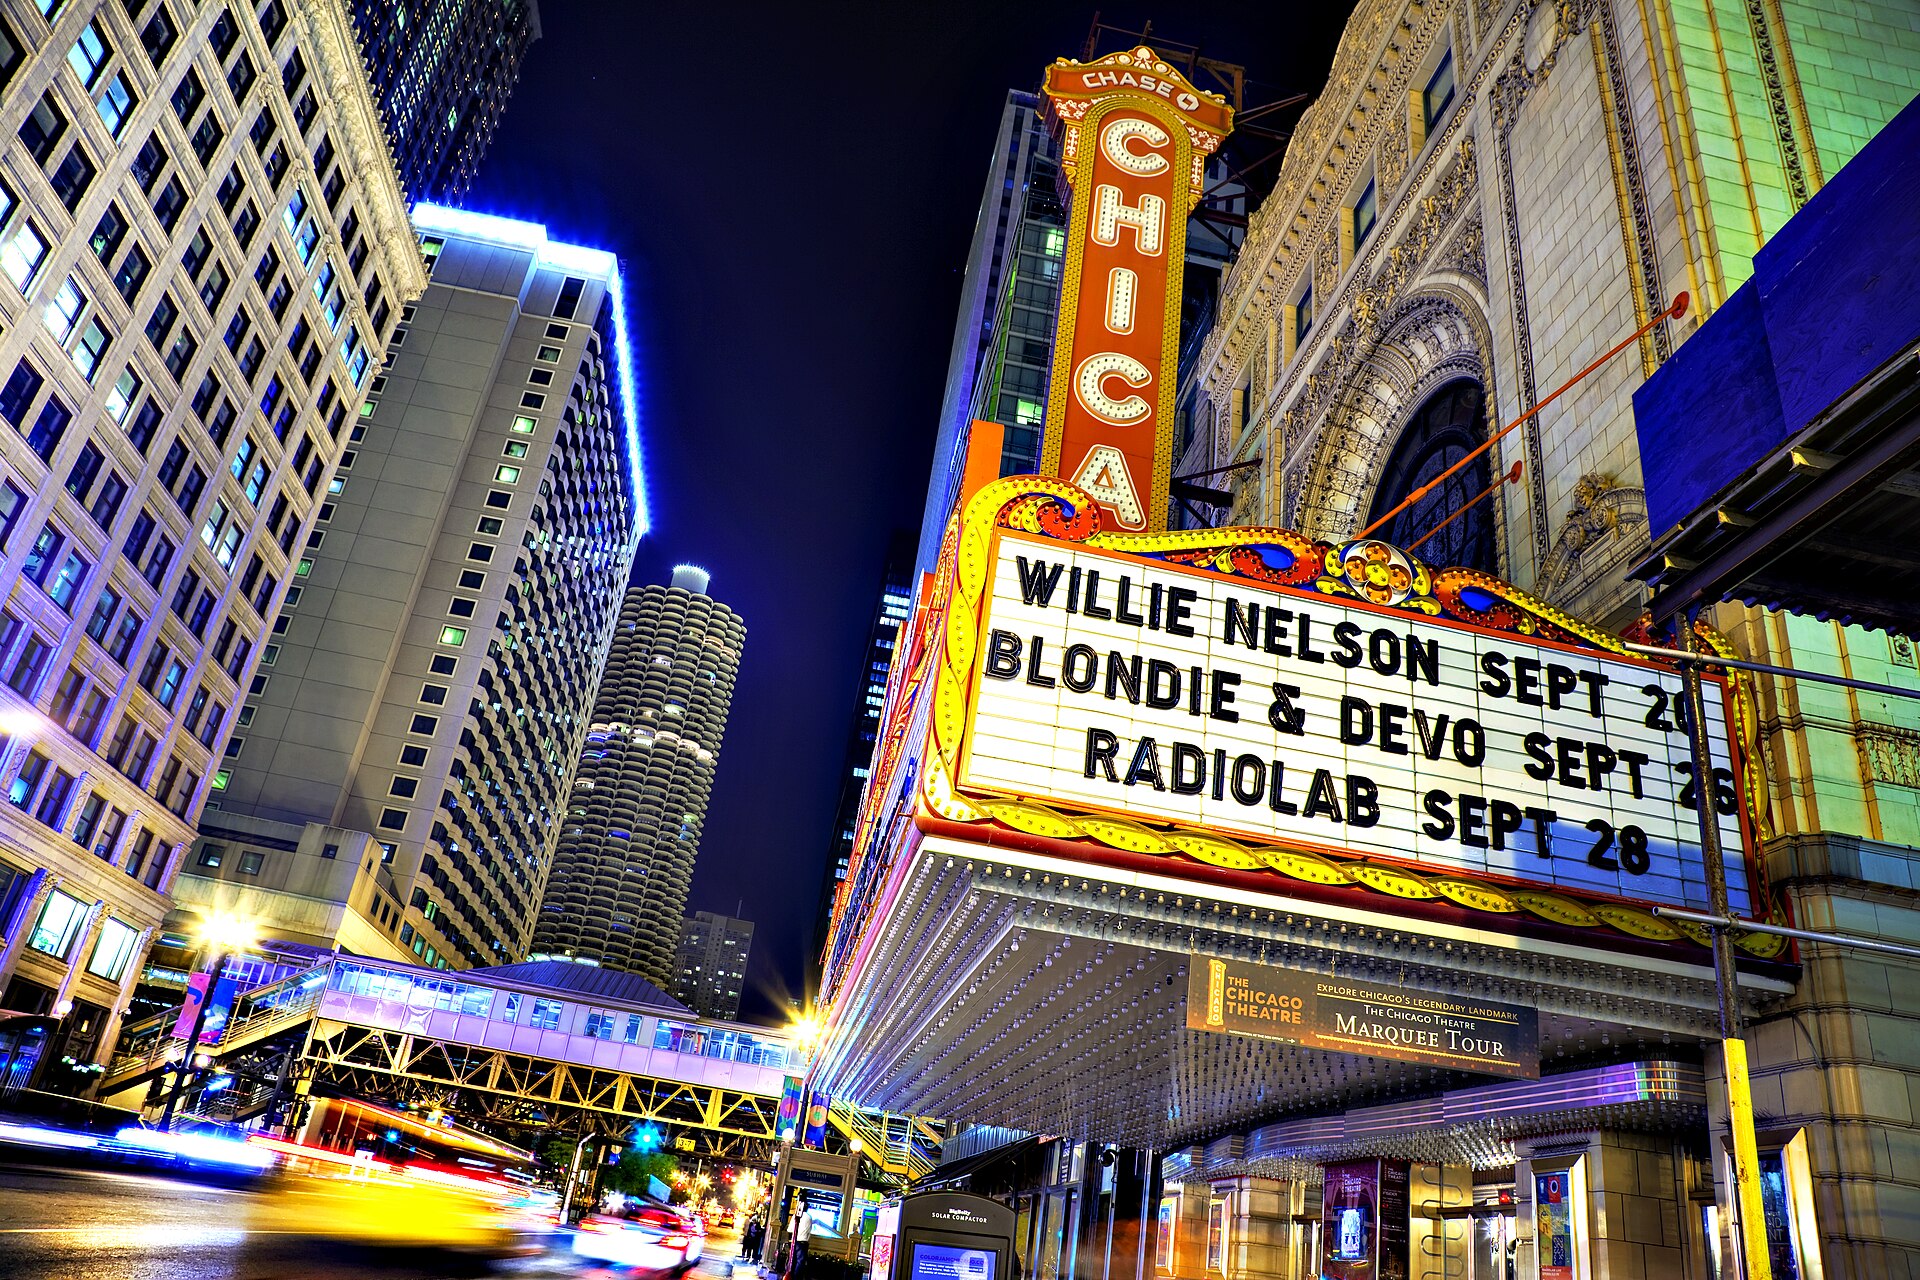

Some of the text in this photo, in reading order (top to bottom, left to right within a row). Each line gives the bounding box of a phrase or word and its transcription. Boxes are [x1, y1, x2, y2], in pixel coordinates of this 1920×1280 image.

[1082, 71, 1174, 98] CHASE
[1016, 555, 1197, 637] WILLIE
[1223, 597, 1439, 686] NELSON
[1480, 651, 1609, 718] SEPT
[985, 628, 1738, 816] BLONDIE & DEVO SEPT 26
[1084, 727, 1651, 875] RADIOLAB SEPT 28
[1212, 964, 1222, 1021] CHICAGO
[1226, 987, 1303, 1010] CHICAGO
[1228, 976, 1249, 988] THE
[1226, 1001, 1302, 1025] THEATRE
[1317, 984, 1519, 1021] EXPLORE CHICAGO'S LEGENDARY LANDMARK
[1335, 1013, 1505, 1057] MARQUEE TOUR
[952, 1214, 988, 1223] COMPACTOR
